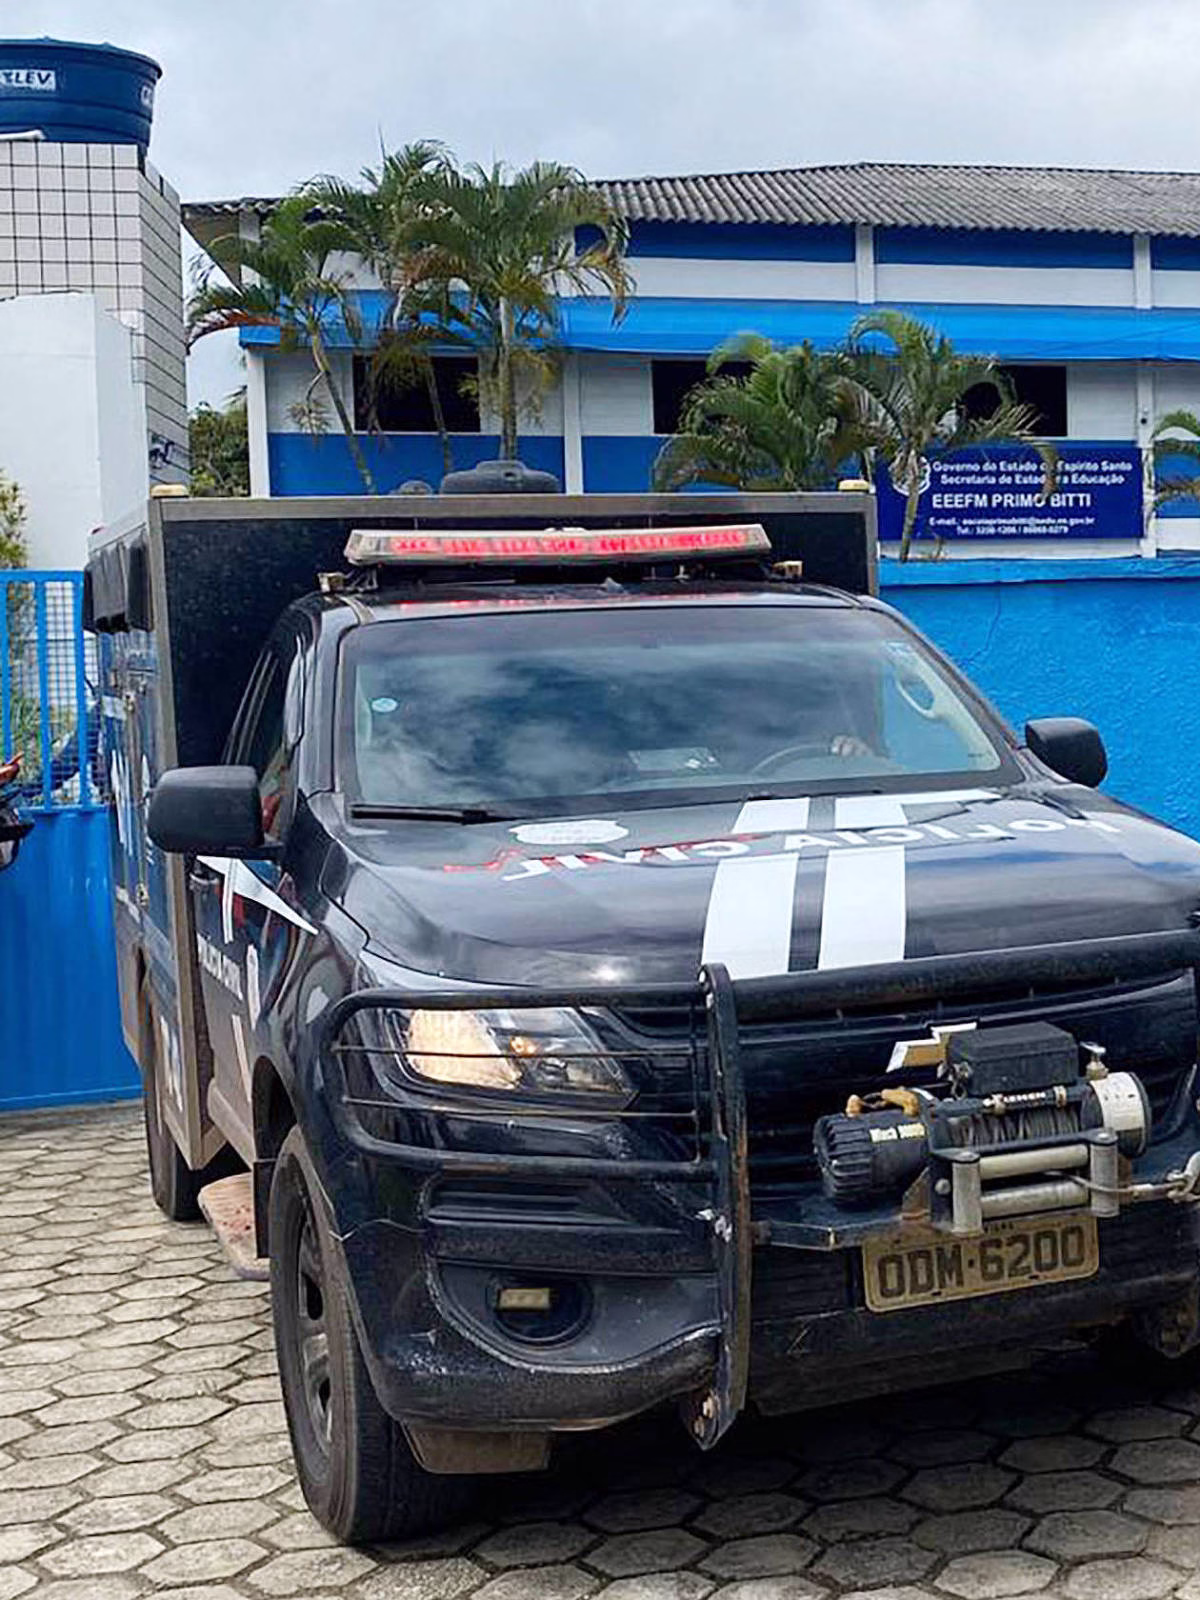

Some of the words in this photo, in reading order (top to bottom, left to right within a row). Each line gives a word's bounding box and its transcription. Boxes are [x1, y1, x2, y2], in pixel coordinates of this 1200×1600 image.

[932, 460, 980, 472] Governo
[982, 461, 997, 472] do
[999, 460, 1038, 472] Estado
[1101, 460, 1133, 472] Santo
[941, 473, 996, 485] Secretaria
[998, 473, 1012, 485] de
[1014, 473, 1053, 485] Estad
[1071, 473, 1125, 486] Educação
[932, 493, 988, 509] EEEFM
[991, 493, 1046, 509] PRIMO
[1050, 493, 1092, 509] BITTI
